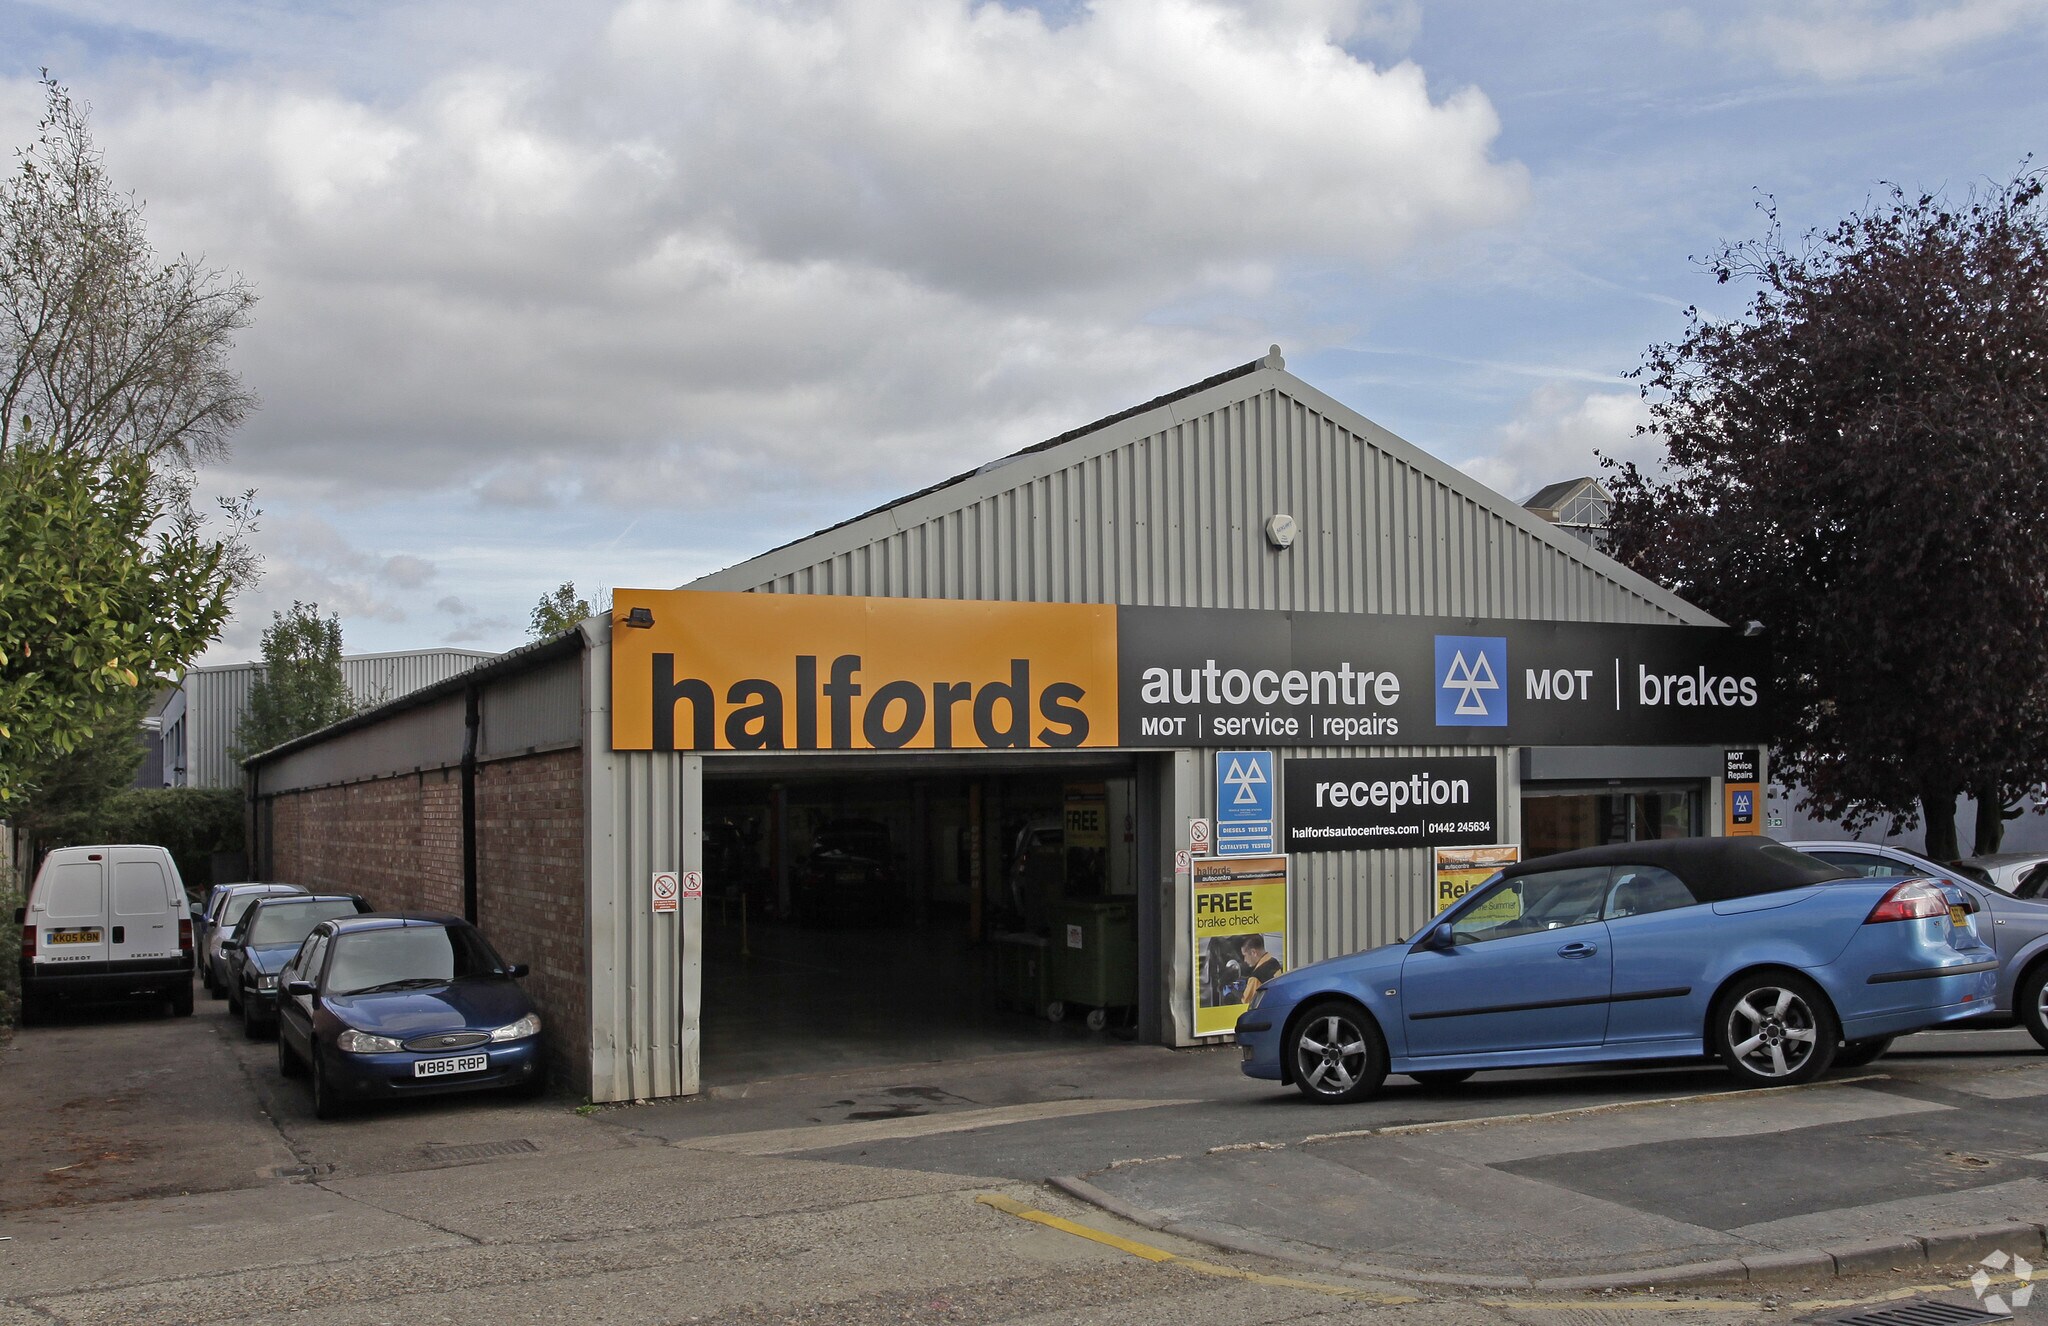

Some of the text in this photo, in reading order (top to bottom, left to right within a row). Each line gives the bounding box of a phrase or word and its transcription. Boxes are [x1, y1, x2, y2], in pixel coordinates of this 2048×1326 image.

[1141, 659, 1400, 706] autocentre
[1526, 669, 1593, 700] MOT
[1639, 664, 1758, 706] brakes
[652, 652, 1090, 750] halfords
[1141, 712, 1399, 740] MOT service repairs
[1728, 752, 1743, 760] MOT
[1728, 762, 1752, 770] Service
[1728, 771, 1753, 780] Repairs
[1316, 772, 1469, 814] reception
[1066, 810, 1098, 831] FREE
[1292, 821, 1490, 838] halfordsautocentres.com 01442 245634
[1196, 866, 1231, 876] halfords
[1197, 891, 1252, 914] FREE
[1197, 913, 1259, 928] brake check
[52, 931, 99, 943] KK05 KBN
[417, 1056, 485, 1075] W885 RBP
